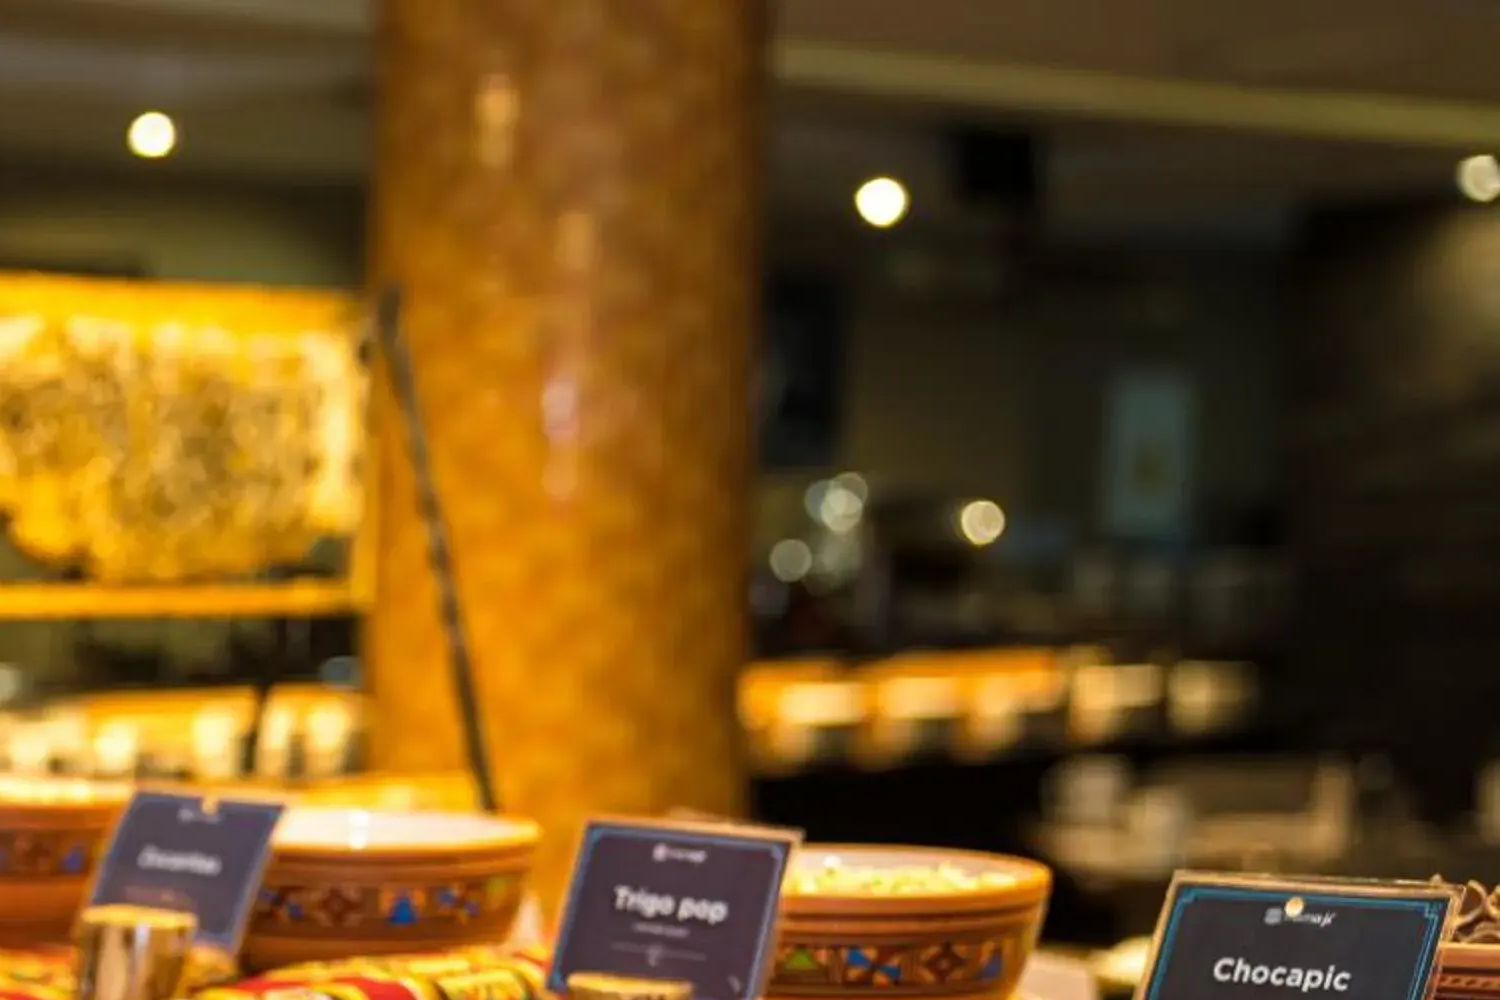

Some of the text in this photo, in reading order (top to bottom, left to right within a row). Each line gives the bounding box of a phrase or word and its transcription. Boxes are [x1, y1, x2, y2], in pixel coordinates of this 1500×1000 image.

[615, 885, 728, 924] Trigo pop
[1213, 957, 1351, 993] Chocapic
